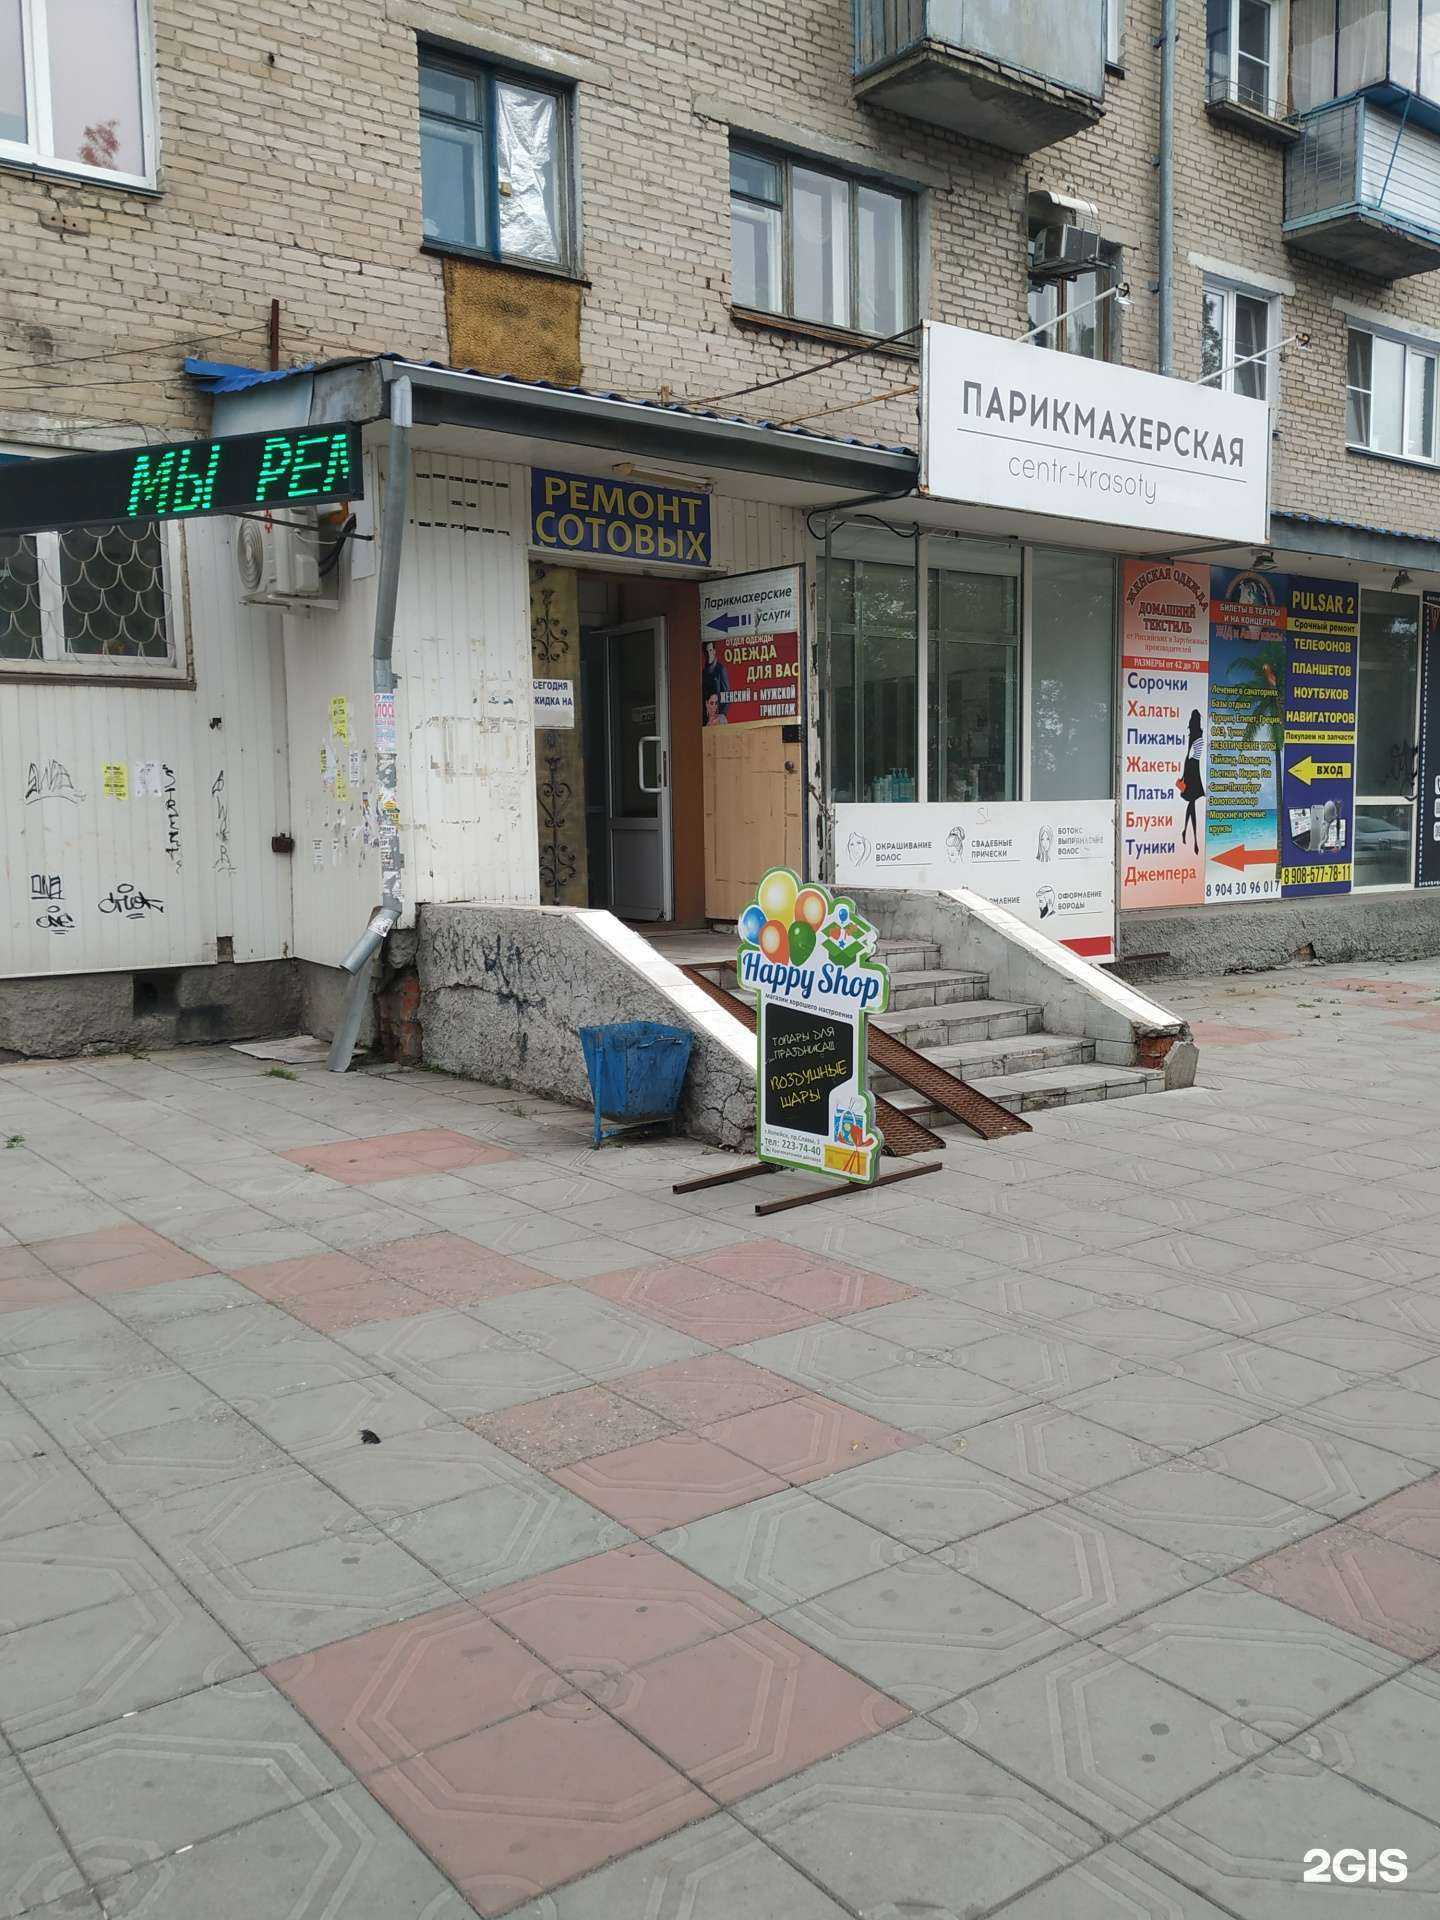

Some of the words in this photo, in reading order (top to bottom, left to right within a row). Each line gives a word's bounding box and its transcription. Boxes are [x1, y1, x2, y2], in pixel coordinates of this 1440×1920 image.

[963, 380, 1244, 467] ПАРИКМАХЕРСКАЯ
[127, 445, 221, 516] МЫ
[1009, 457, 1157, 504] centr-krasoty
[545, 476, 702, 525] РЕМОНТ
[536, 510, 707, 561] СОТОВЫХ
[704, 587, 792, 610] Парикмахерские
[1127, 568, 1172, 605] ЖЕНСКАЯ
[1172, 569, 1208, 613] ОДЕЖДА
[1138, 601, 1196, 618] ДОМАШНИЙ
[1219, 604, 1248, 614] БИЛЕТЫ
[1249, 606, 1254, 614] В
[1255, 607, 1281, 617] ТЕАТРЫ
[1292, 590, 1344, 614] PULSAR
[1347, 597, 1354, 615] 2
[757, 609, 791, 624] услуги
[1231, 615, 1240, 623] НА
[1240, 616, 1276, 626] КОНЦЕРТЫ
[1143, 618, 1192, 634] ТЕКСТИЛЬ
[1294, 619, 1328, 631] Срочный
[1329, 624, 1356, 635] ремонт
[725, 637, 745, 648] ОТДЕЛ
[745, 634, 774, 646] ОДЕЖДЫ
[1294, 638, 1352, 653] ТЕЛЕФОНОВ
[724, 644, 777, 664] ОДЕЖДА
[1134, 657, 1165, 669] РАЗМЕРЫ
[1292, 662, 1352, 676] ПЛАНШЕТОВ
[747, 665, 772, 683] ДЛЯ
[775, 662, 799, 678] ВАС
[533, 681, 568, 691] СЕГОДНЯ
[1127, 672, 1188, 694] Сорочки
[534, 696, 560, 706] КИДКА
[562, 697, 573, 706] НА
[720, 688, 751, 704] ЖЕНСКИЙ
[760, 685, 796, 701] МУЖСКОЙ
[1293, 686, 1349, 700] НОУТБУКОВ
[760, 703, 796, 716] ТРИКОТАЖ
[1127, 700, 1180, 718] Халаты
[1286, 710, 1355, 724] НАВИГАТОРОВ
[1127, 729, 1186, 746] Пижамы
[1285, 731, 1317, 742] Покупаем
[1318, 733, 1325, 741] на
[1327, 734, 1354, 742] запчасти
[1126, 756, 1181, 773] Жакеты
[1316, 765, 1343, 777] ВХОД
[1126, 784, 1174, 800] Платья
[1125, 811, 1173, 832] Блузки
[875, 841, 932, 851] ОКРАШИВАНИЕ
[971, 839, 1013, 848] СВАДЕБНЫЕ
[1057, 847, 1079, 856] ВОЛОС
[1125, 839, 1175, 859] Туники
[875, 853, 902, 862] ВОЛОС
[971, 850, 1007, 859] ПРИЧЕСКИ
[1124, 866, 1197, 886] Джемпера
[1284, 870, 1289, 884] 8
[1291, 865, 1352, 883] 908-577-78-11
[1057, 890, 1103, 900] ОФОРМЛЕНИЕ
[1206, 885, 1211, 897] 8
[1215, 883, 1233, 897] 904
[1235, 882, 1247, 894] 30
[1250, 881, 1261, 894] 96
[1263, 880, 1280, 893] 017
[1057, 902, 1085, 910] БОРОДЫ
[742, 952, 815, 999] Happy
[817, 963, 880, 1008] Shop
[765, 993, 789, 1003] магазин
[789, 1000, 817, 1011] хорошего
[818, 1006, 853, 1020] настроения
[772, 1031, 810, 1047] ТОВАРЫ
[813, 1026, 835, 1039] ДЛЯ
[770, 1059, 847, 1091] ВОЗДУШНЫЕ
[780, 1088, 821, 1109] ШАРЫ
[765, 1138, 780, 1148] тел:
[782, 1140, 821, 1156] 223-74-40
